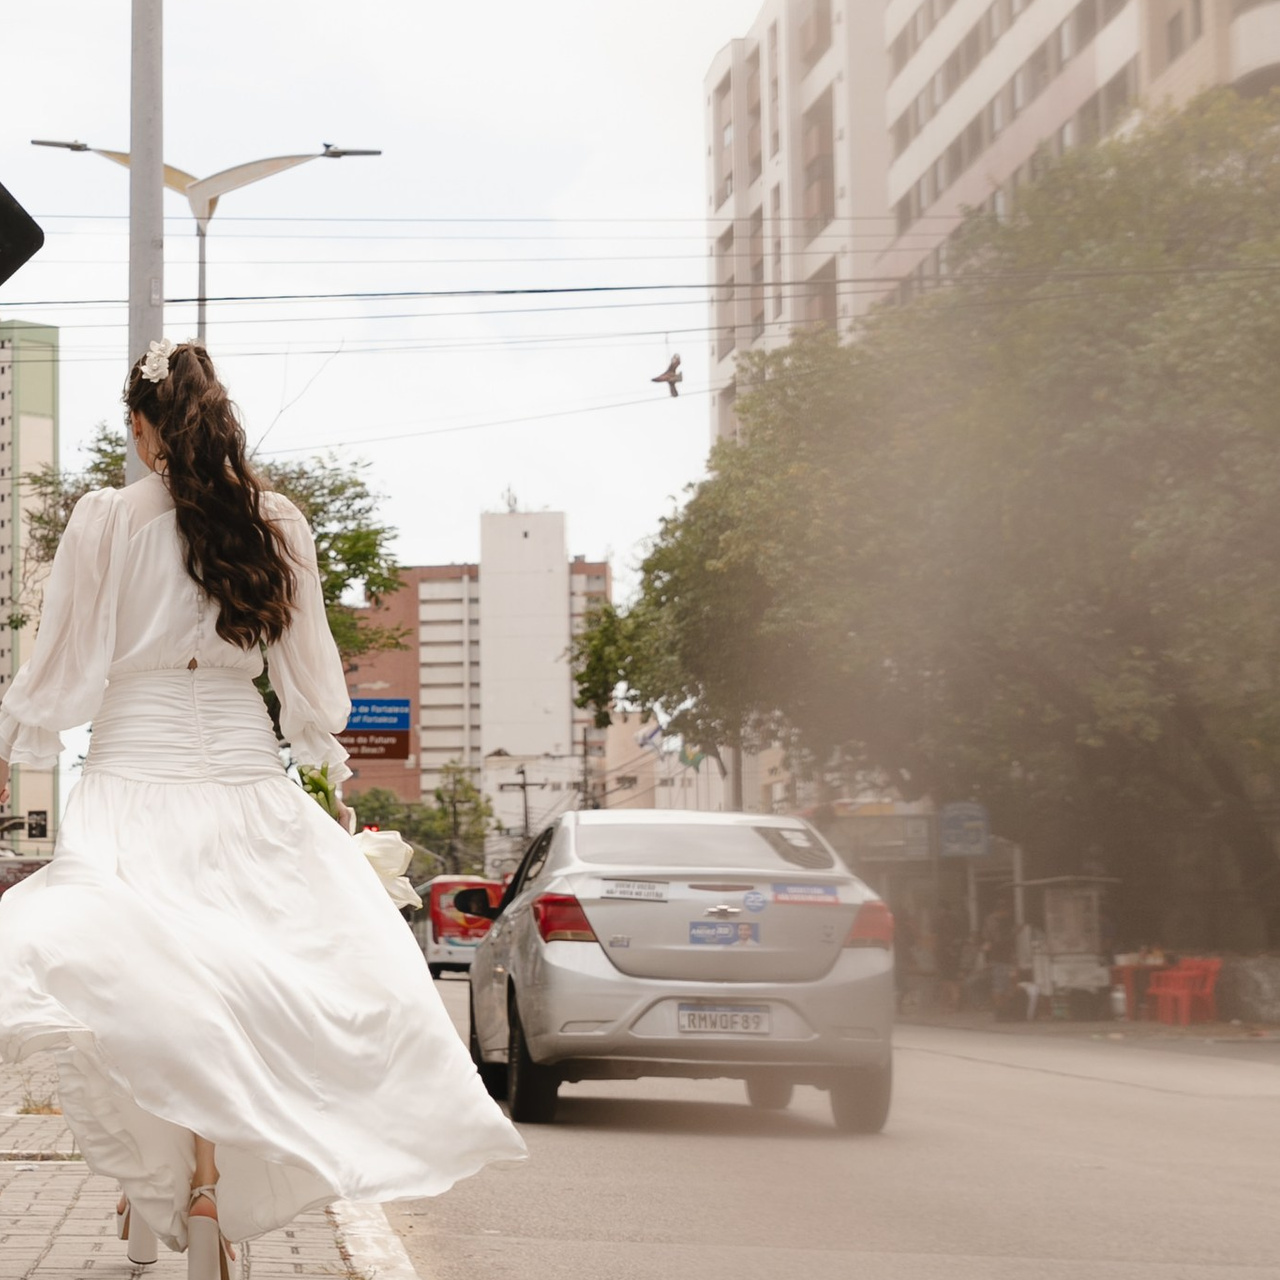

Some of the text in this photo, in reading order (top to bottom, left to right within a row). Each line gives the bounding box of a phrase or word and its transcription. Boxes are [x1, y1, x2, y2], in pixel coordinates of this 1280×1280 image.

[371, 704, 410, 714] Fortaleza
[369, 734, 398, 745] Futuro
[745, 894, 764, 907] 22
